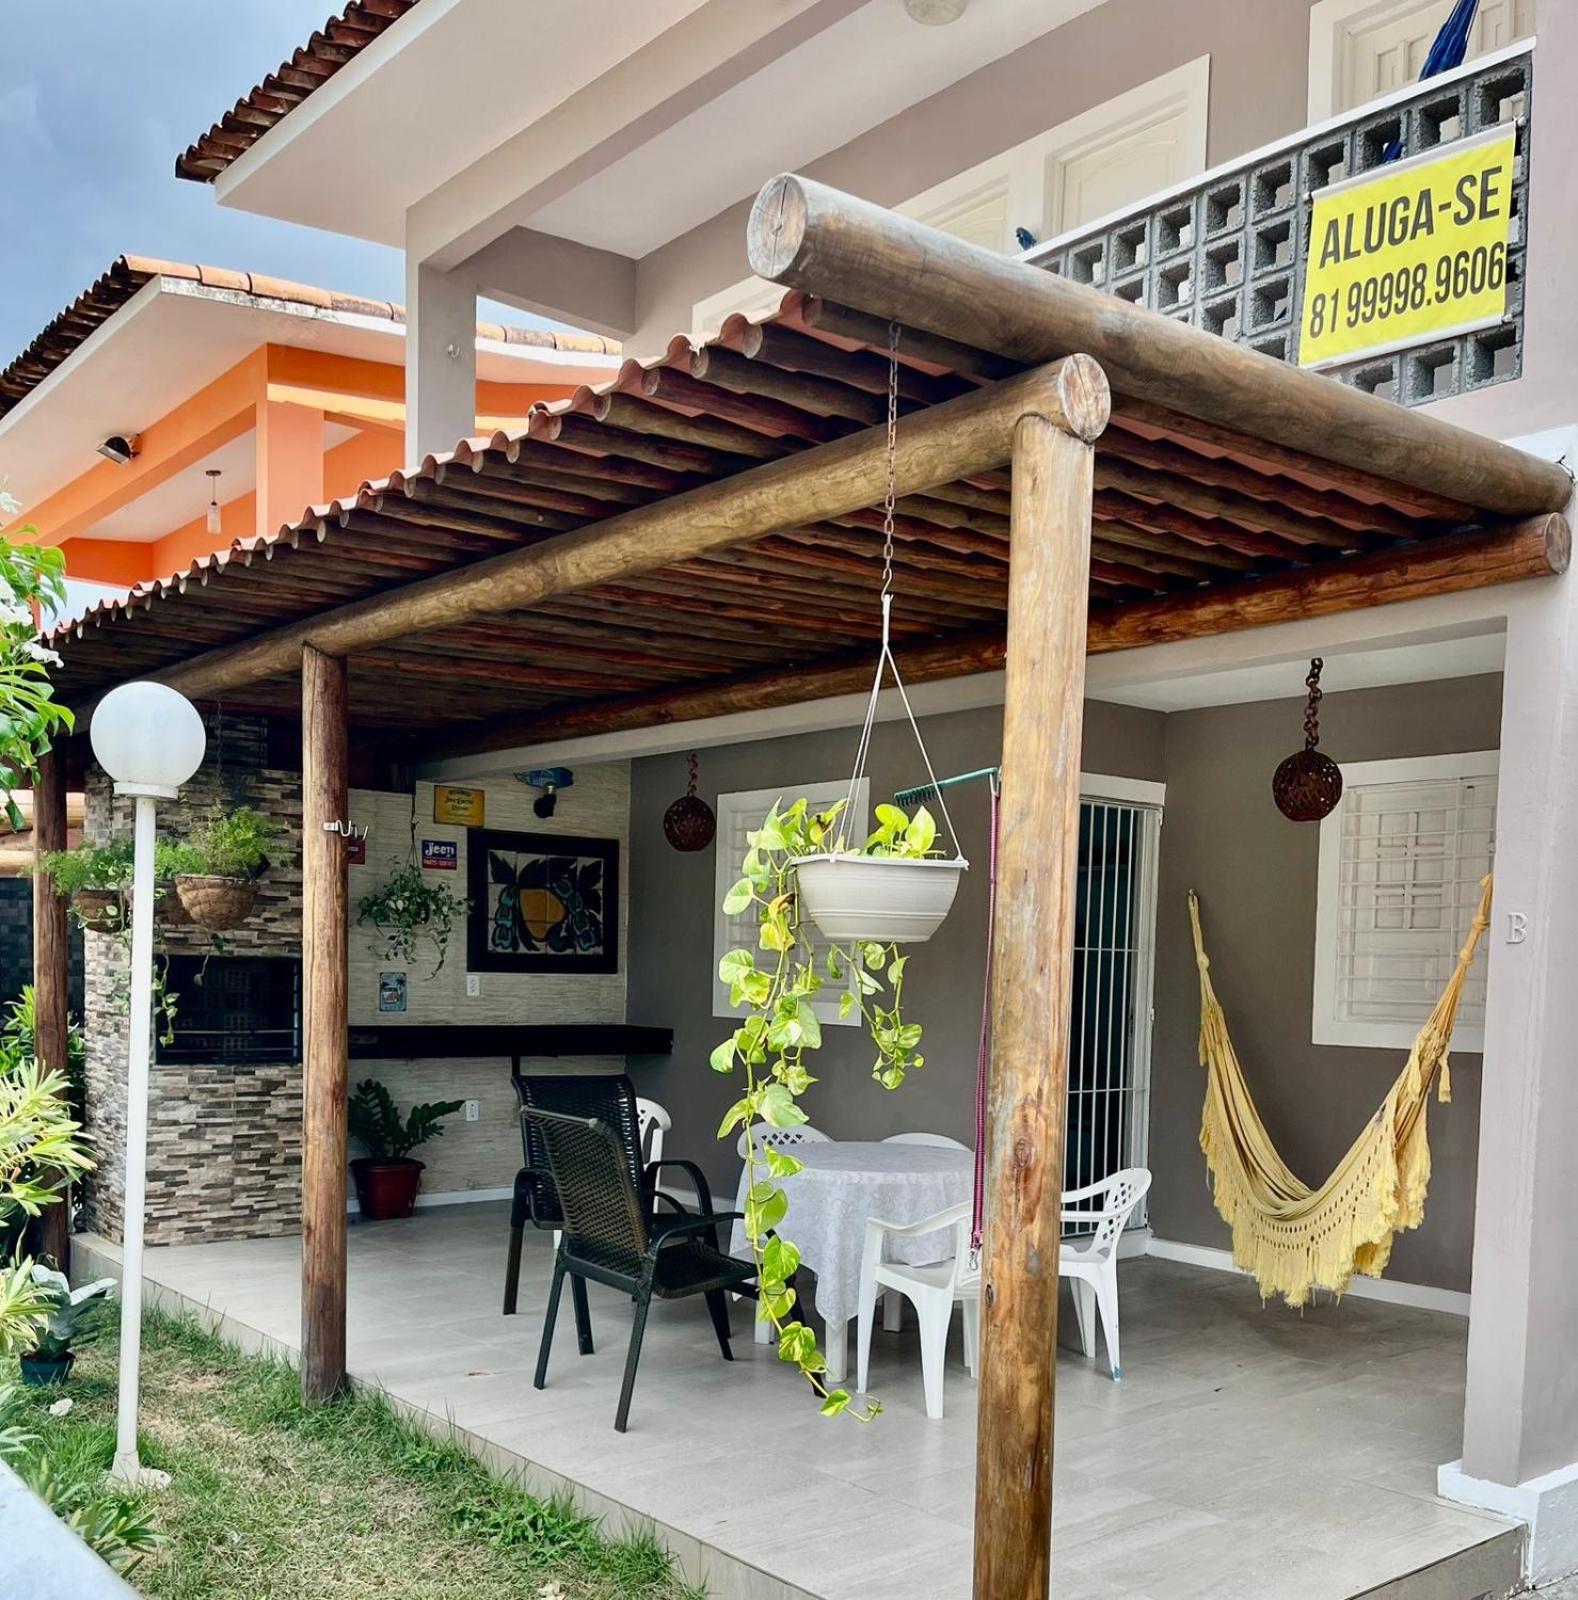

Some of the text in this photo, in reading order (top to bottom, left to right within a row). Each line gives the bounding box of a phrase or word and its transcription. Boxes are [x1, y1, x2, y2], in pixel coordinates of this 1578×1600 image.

[1319, 166, 1502, 269] ALUGA-SE
[1309, 241, 1505, 338] 81 99998.9606
[1505, 912, 1528, 945] B
